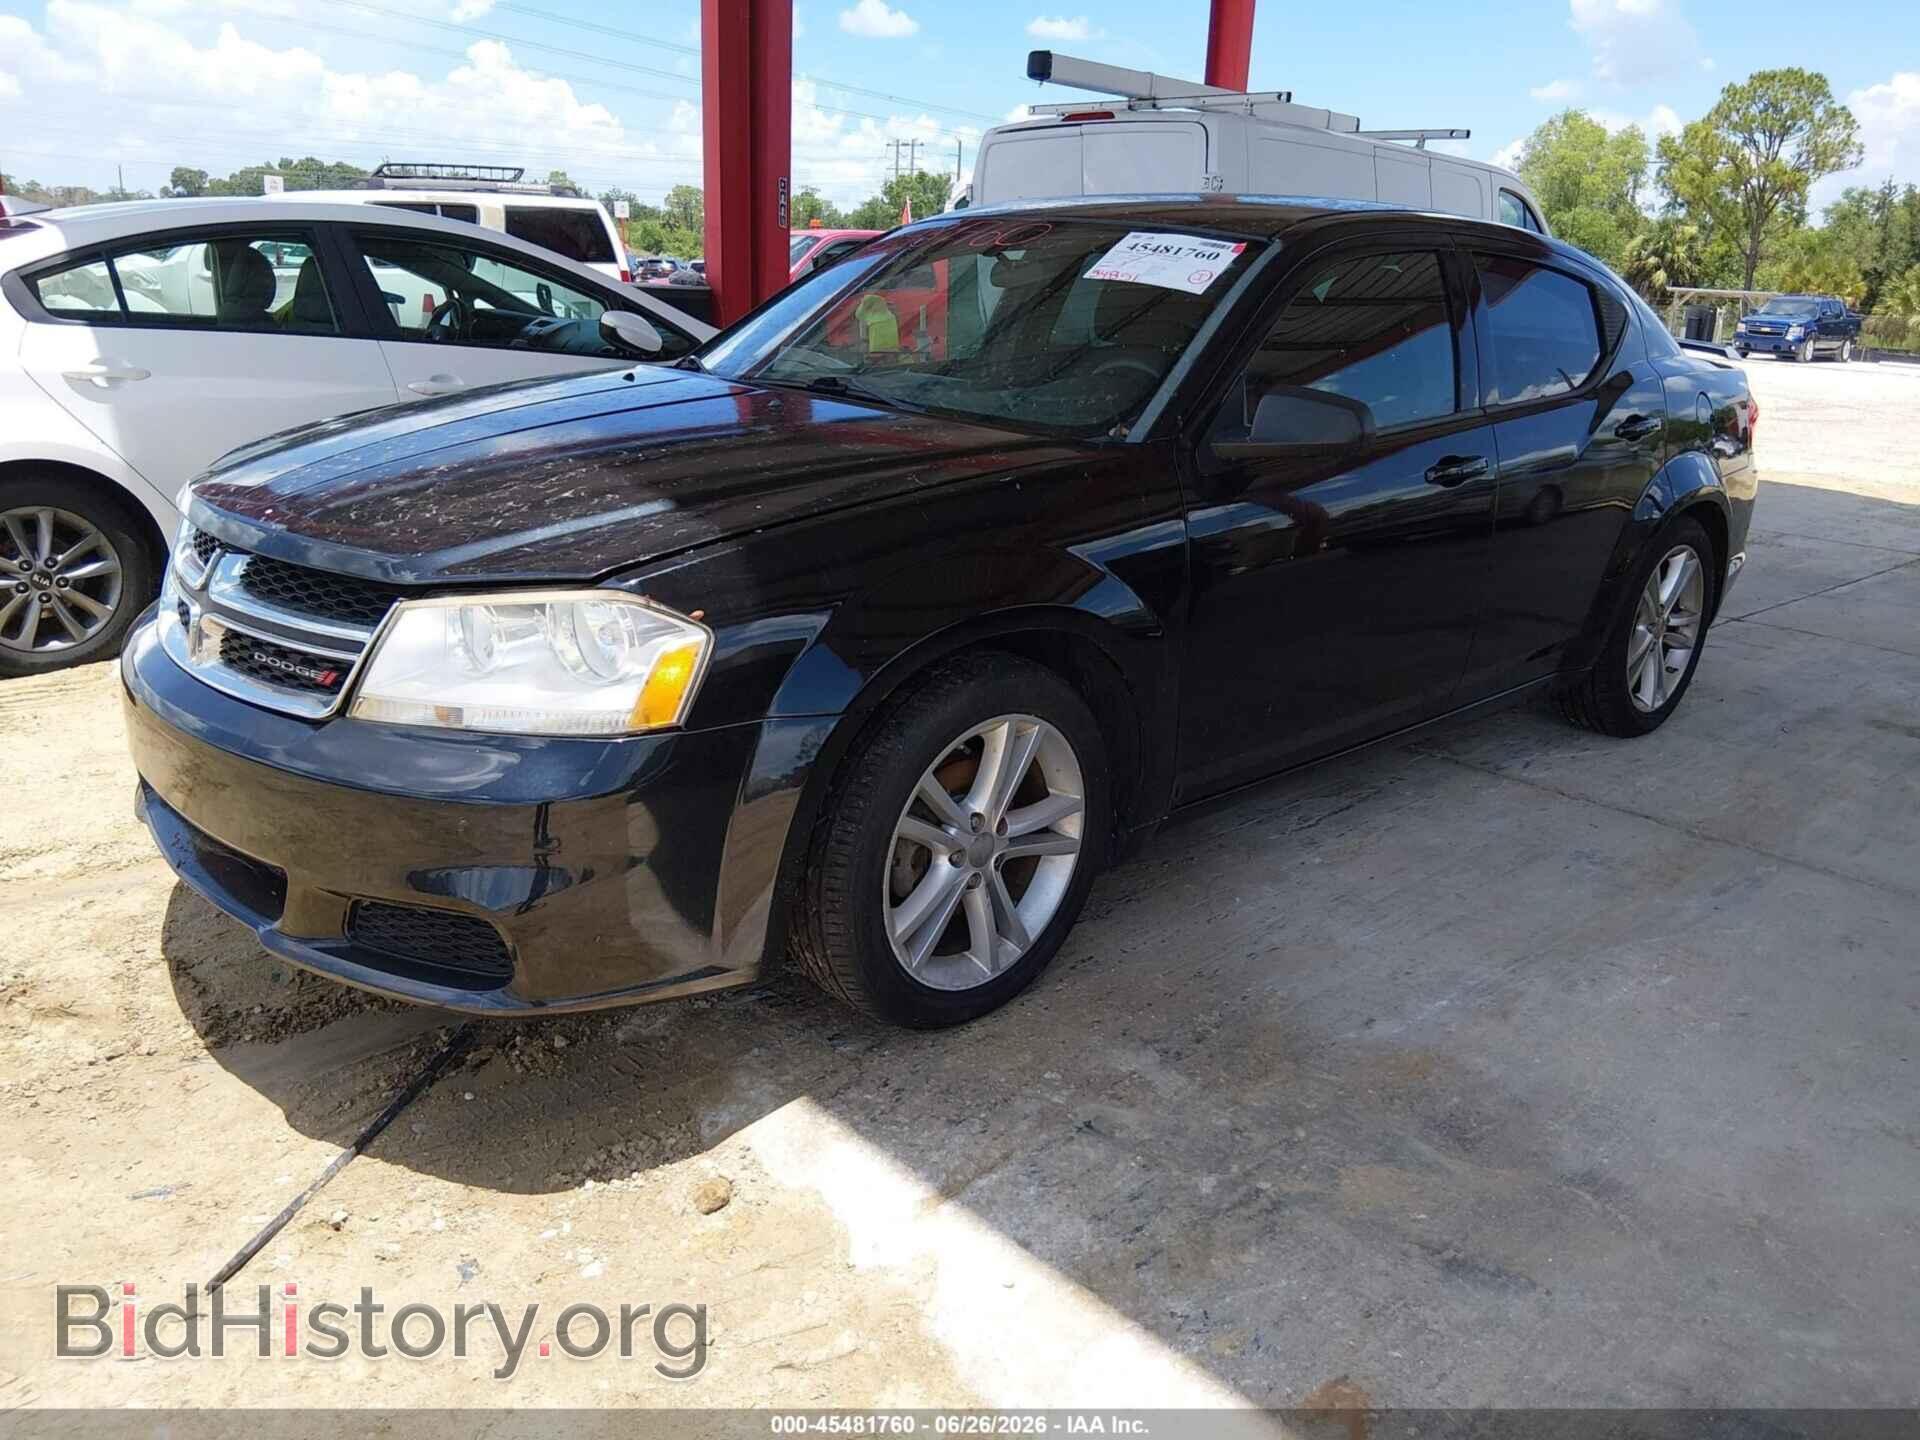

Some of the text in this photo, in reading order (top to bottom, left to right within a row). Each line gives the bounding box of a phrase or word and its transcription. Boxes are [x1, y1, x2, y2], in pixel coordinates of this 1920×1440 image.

[1127, 242, 1221, 261] 45481760
[32, 573, 50, 586] KIA
[254, 652, 324, 680] DODGE
